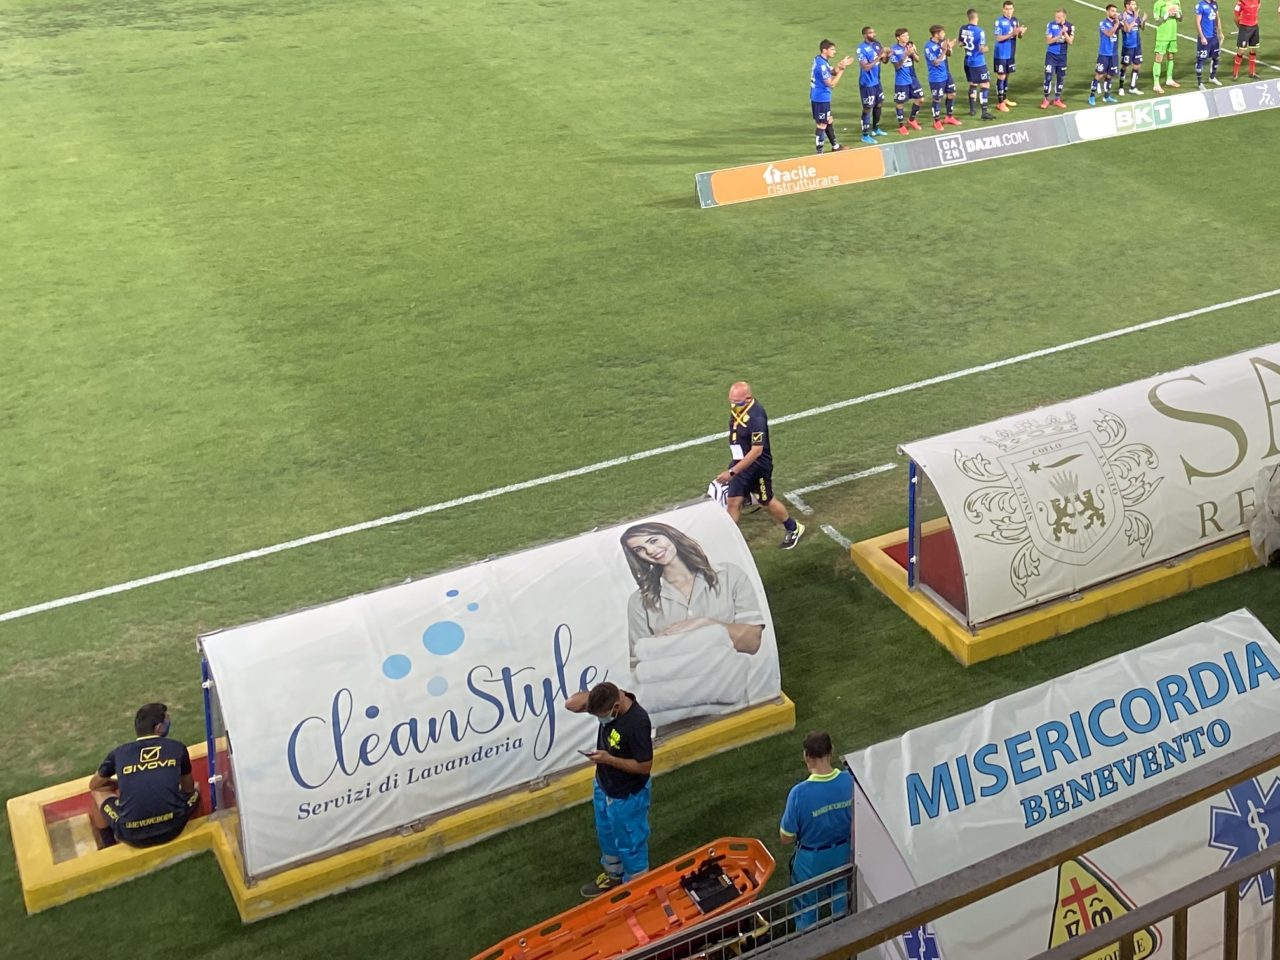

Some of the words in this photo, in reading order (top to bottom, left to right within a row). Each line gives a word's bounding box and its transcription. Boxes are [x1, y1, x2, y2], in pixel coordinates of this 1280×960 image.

[1116, 101, 1171, 129] BKT
[966, 131, 1030, 153] DAZN.COM
[768, 174, 840, 196] ristrutturare
[122, 759, 176, 775] GIVOVA
[297, 786, 372, 820] Servizi
[378, 774, 400, 793] di
[407, 736, 524, 786] Lavanderia
[1020, 718, 1231, 829] BENEVENTO
